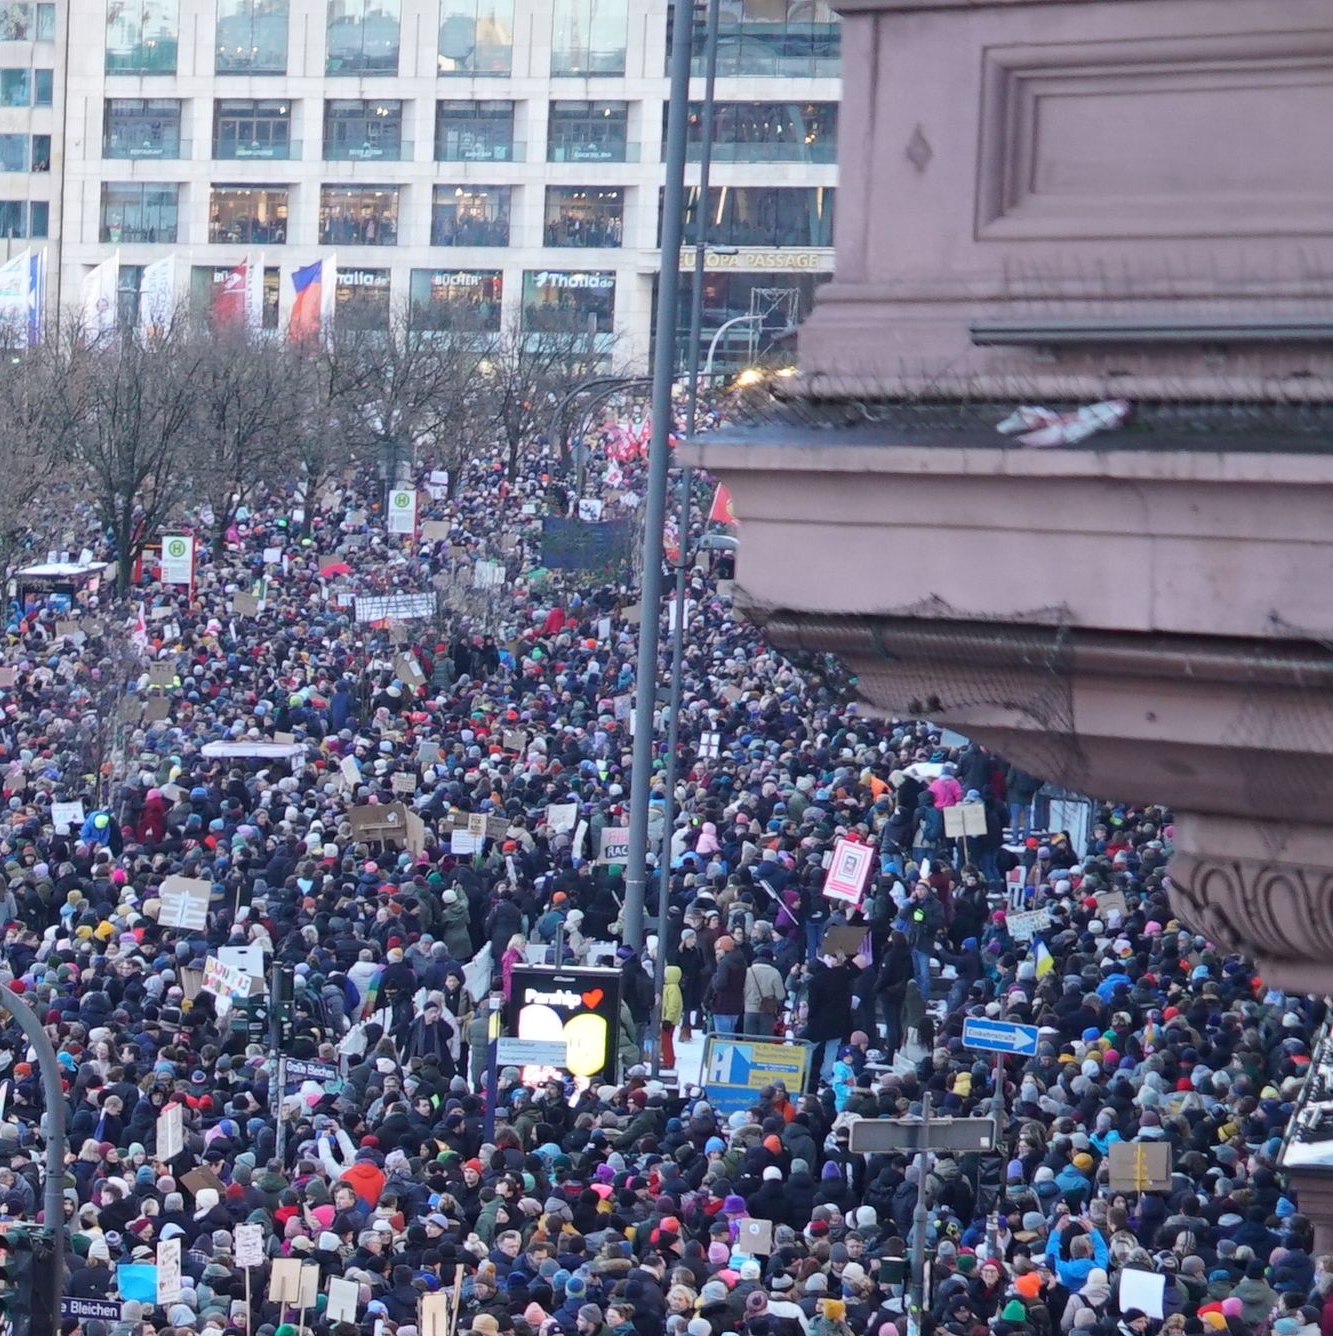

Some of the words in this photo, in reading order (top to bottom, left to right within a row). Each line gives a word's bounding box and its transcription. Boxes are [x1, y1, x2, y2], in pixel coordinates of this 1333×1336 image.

[679, 251, 739, 268] EUOPA
[746, 251, 818, 269] PASSAGE
[525, 988, 582, 1010] Parship
[286, 1060, 307, 1074] Große
[307, 1063, 336, 1080] Bleichen
[70, 1300, 118, 1318] Bleichen
